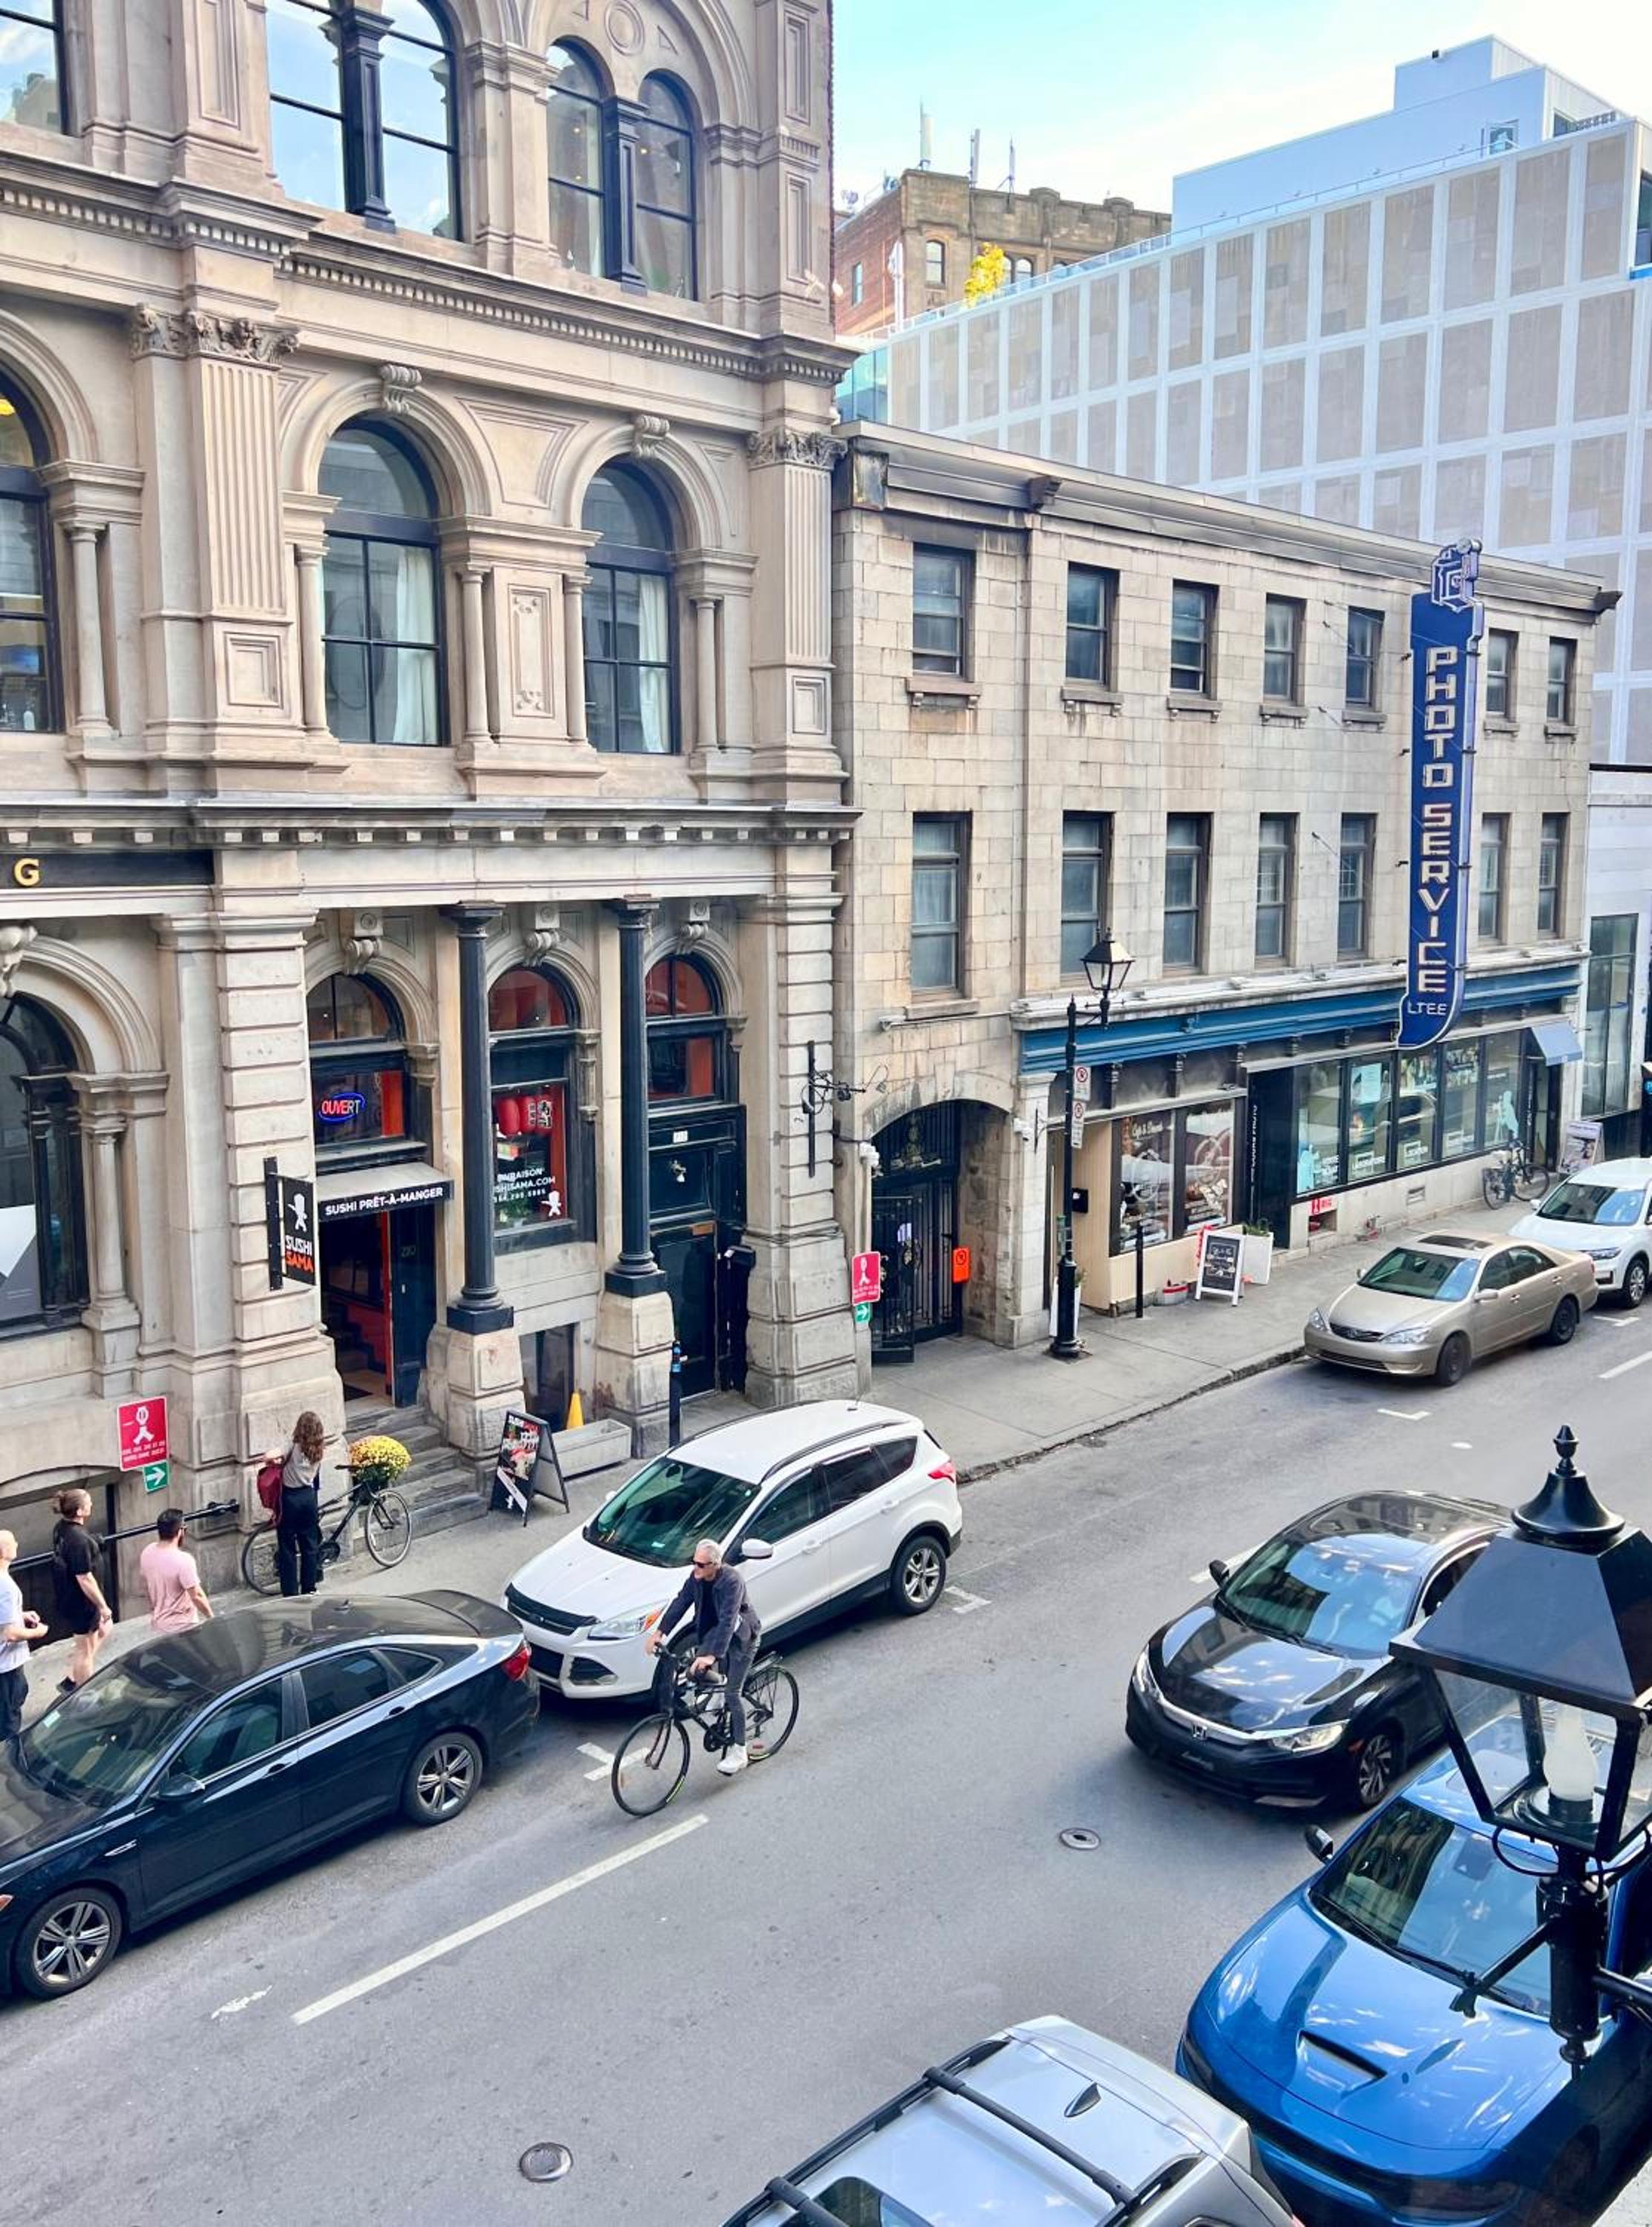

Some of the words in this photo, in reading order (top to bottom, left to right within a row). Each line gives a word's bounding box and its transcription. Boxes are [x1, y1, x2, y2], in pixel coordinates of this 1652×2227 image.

[1423, 646, 1458, 788] PHOTO
[15, 857, 39, 886] G
[1418, 802, 1452, 993] SERVICE
[321, 1099, 361, 1114] OUVERT
[325, 1202, 357, 1215] SUSHI
[359, 1187, 443, 1211] PRÊT-À-MANGER
[285, 1235, 312, 1255] SUSHI
[285, 1251, 314, 1272] SAMA
